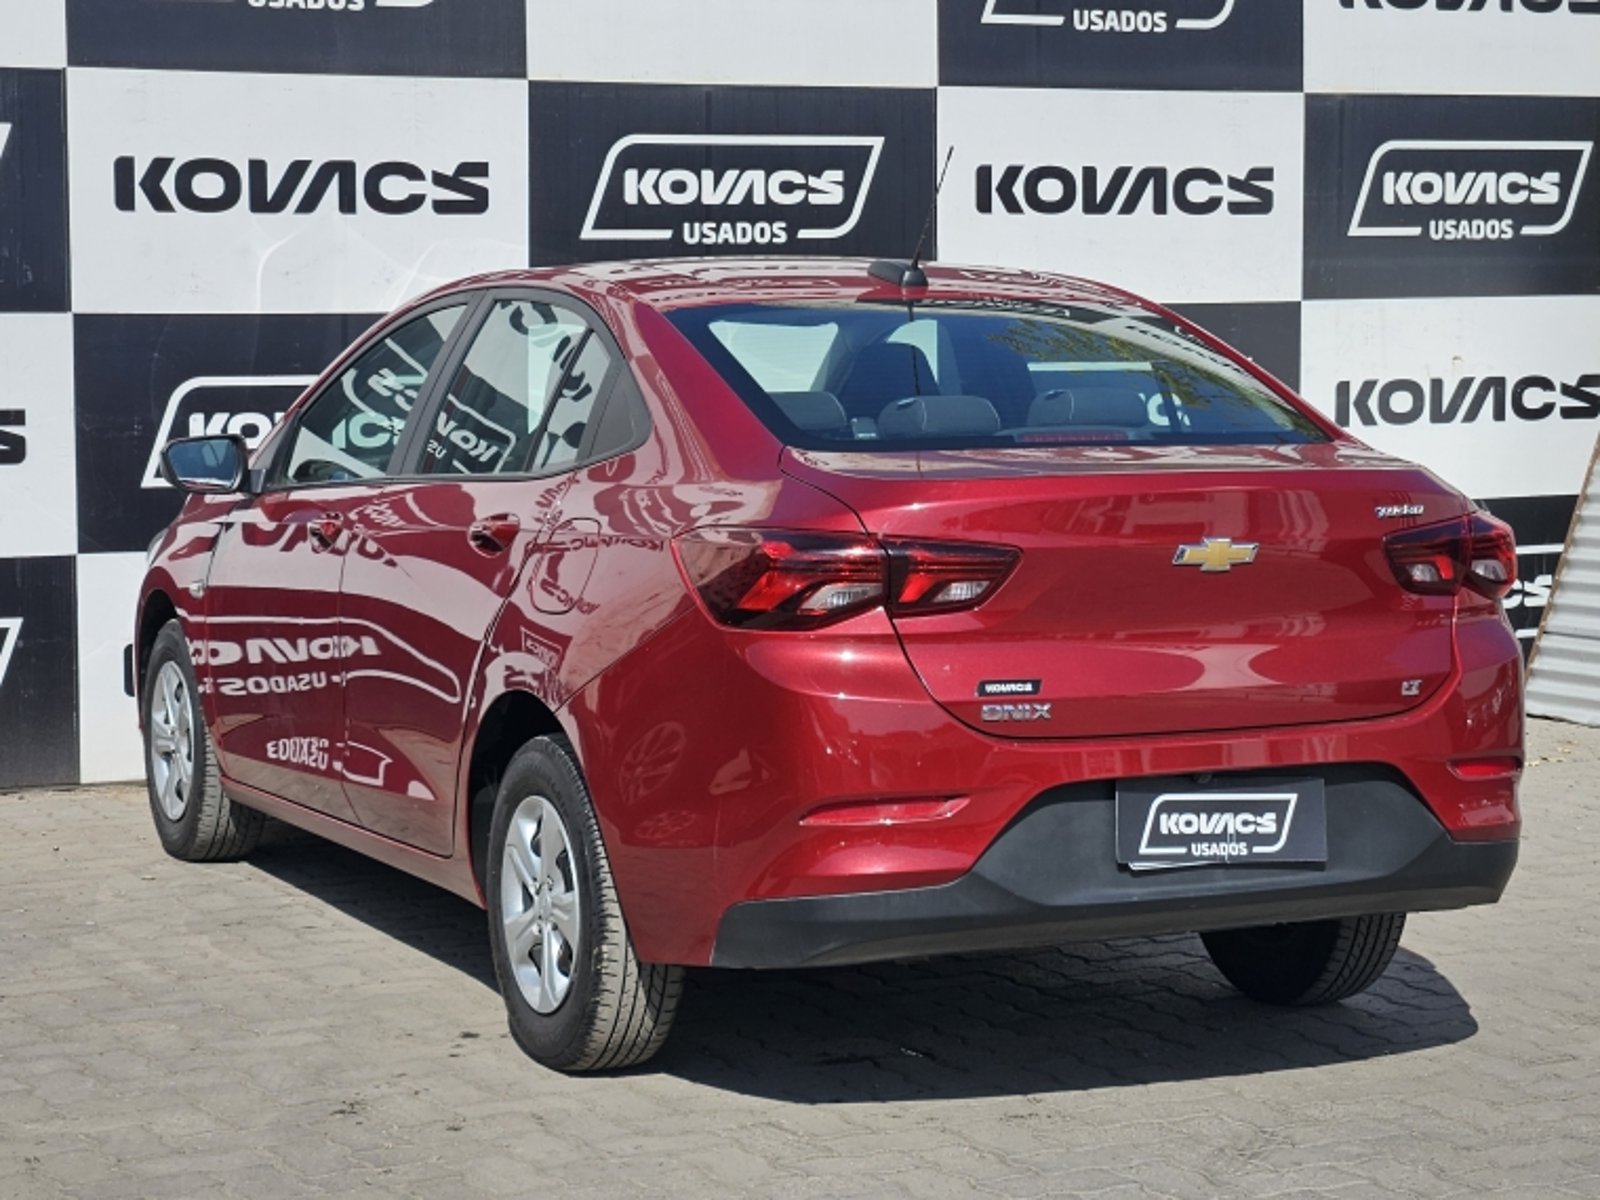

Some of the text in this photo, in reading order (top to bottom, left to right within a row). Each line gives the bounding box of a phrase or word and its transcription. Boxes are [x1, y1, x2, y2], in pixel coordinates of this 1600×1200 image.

[1073, 9, 1168, 33] USADOS
[113, 156, 490, 216] KOVACS
[624, 168, 845, 206] KOVACS
[975, 164, 1275, 216] KOVACS
[1383, 171, 1561, 206] KOVACS
[683, 222, 788, 245] USADOS
[1429, 219, 1514, 241] USADOS
[1335, 374, 1600, 428] KOVACS
[982, 703, 1052, 721] ONIX
[1159, 812, 1278, 836] KOVACS
[1191, 841, 1248, 857] USADOS
